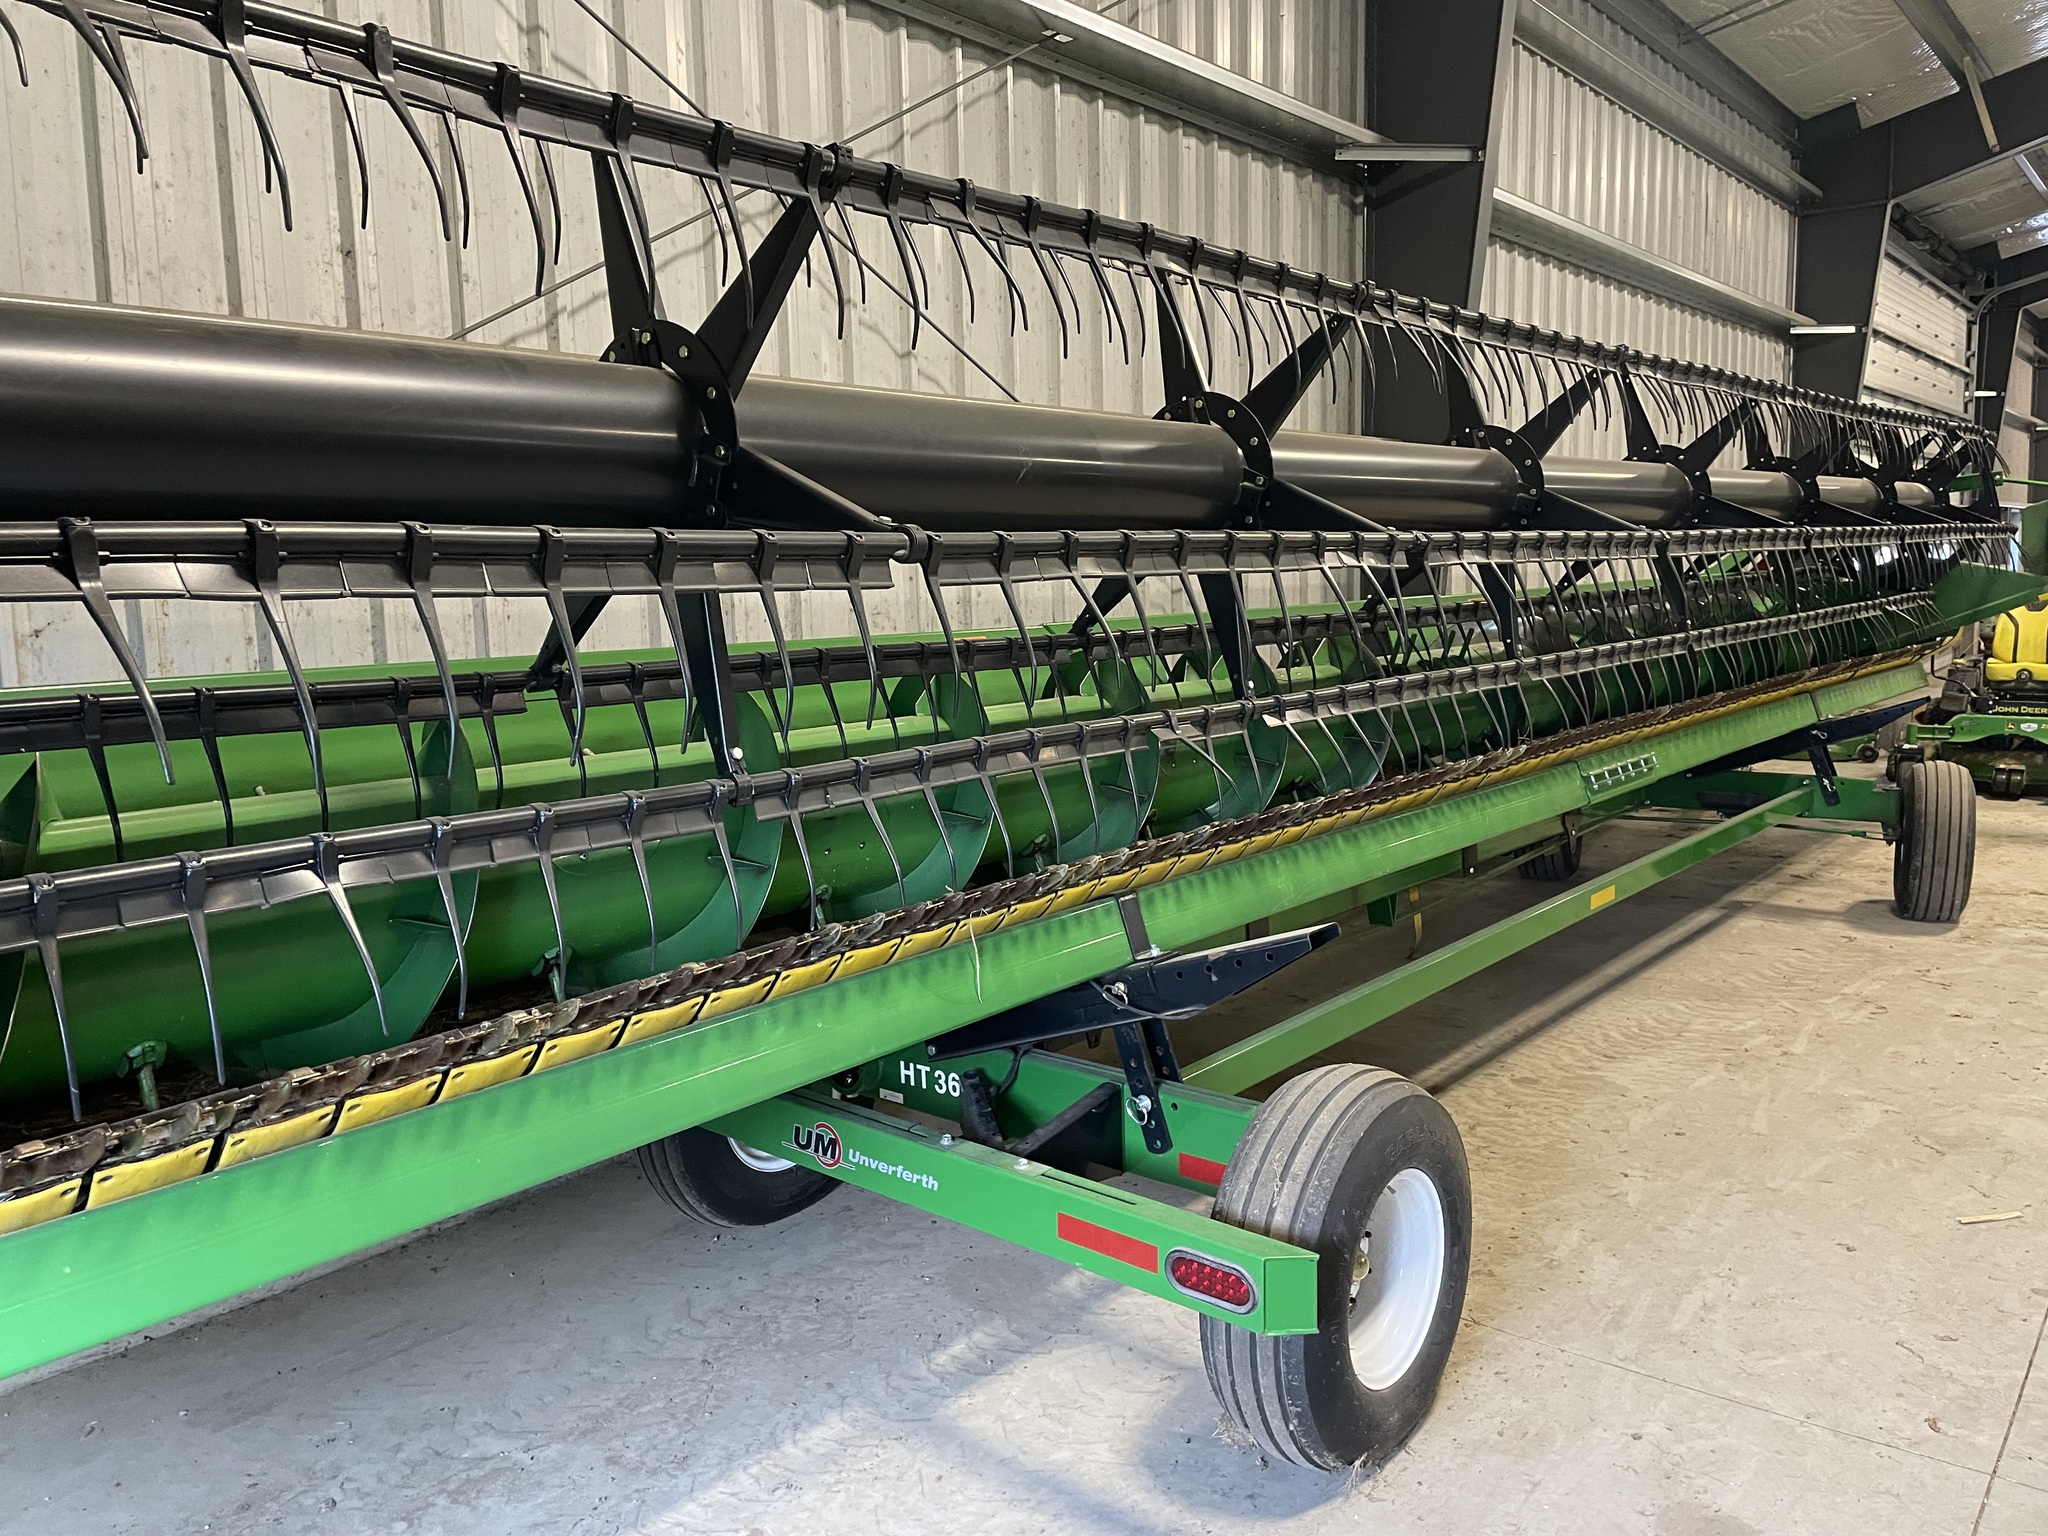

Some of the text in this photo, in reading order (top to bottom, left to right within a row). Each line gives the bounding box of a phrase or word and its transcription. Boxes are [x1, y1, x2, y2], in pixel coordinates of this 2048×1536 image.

[1992, 705, 2048, 714] JOHN DEER
[900, 1060, 961, 1097] HT 36
[792, 1124, 839, 1161] UM
[848, 1148, 938, 1191] Unverferth
